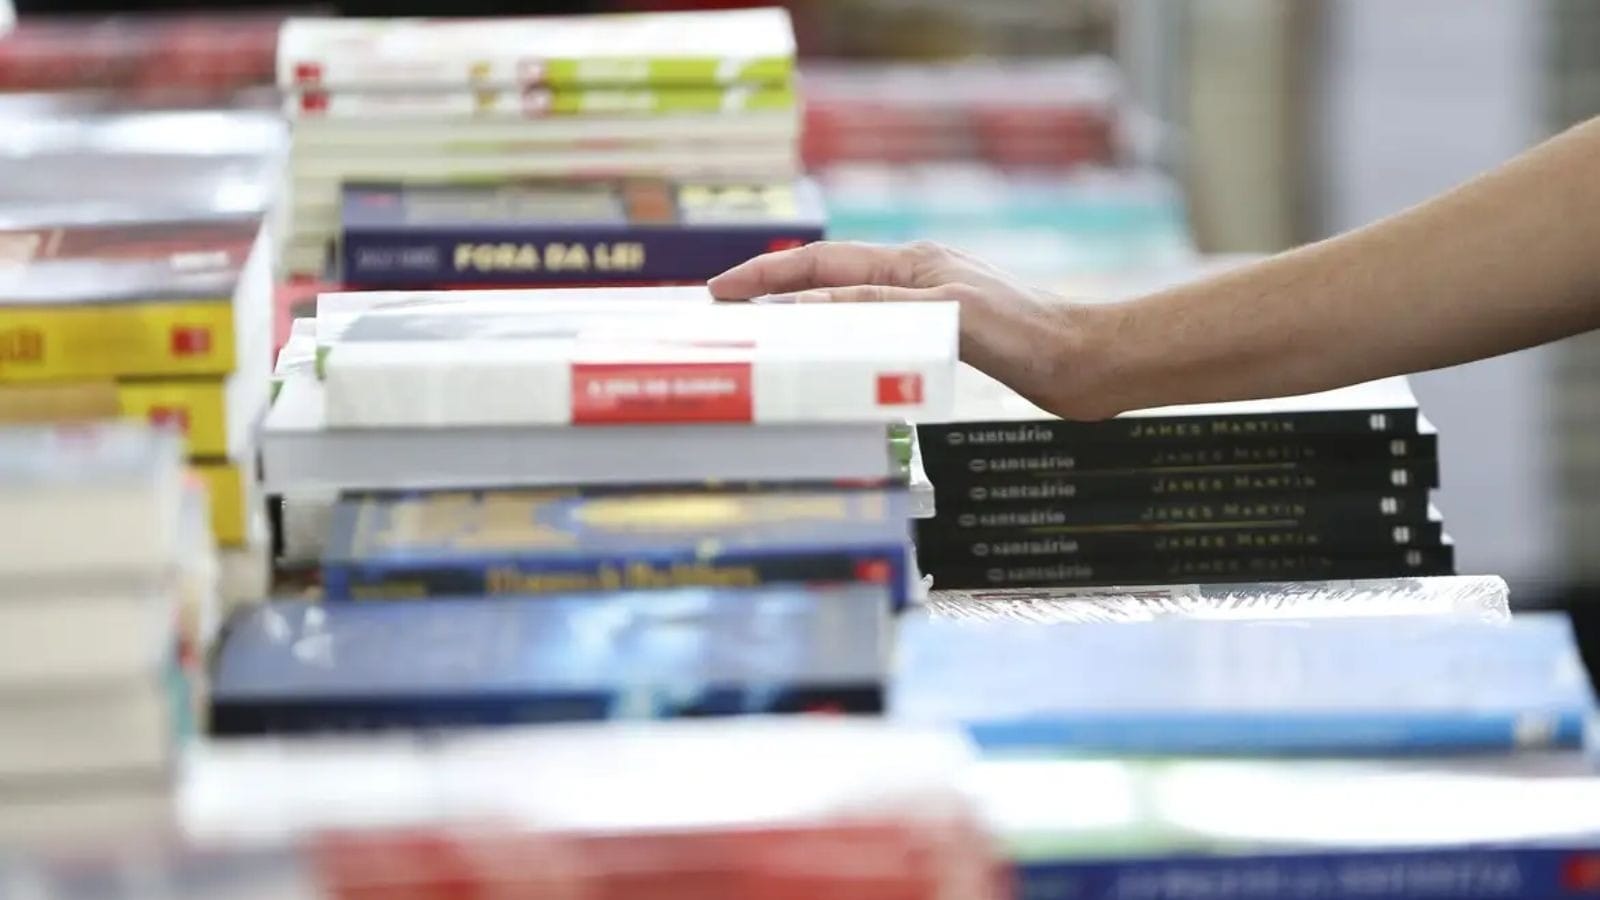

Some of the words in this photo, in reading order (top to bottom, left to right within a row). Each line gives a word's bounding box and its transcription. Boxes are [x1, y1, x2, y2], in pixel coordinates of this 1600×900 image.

[453, 242, 540, 271] FORA
[544, 242, 589, 270] DA
[593, 242, 646, 270] LEI
[968, 425, 1054, 444] santuário
[989, 453, 1075, 471] santuário
[990, 481, 1076, 499] santuário
[979, 508, 1066, 526] santuário
